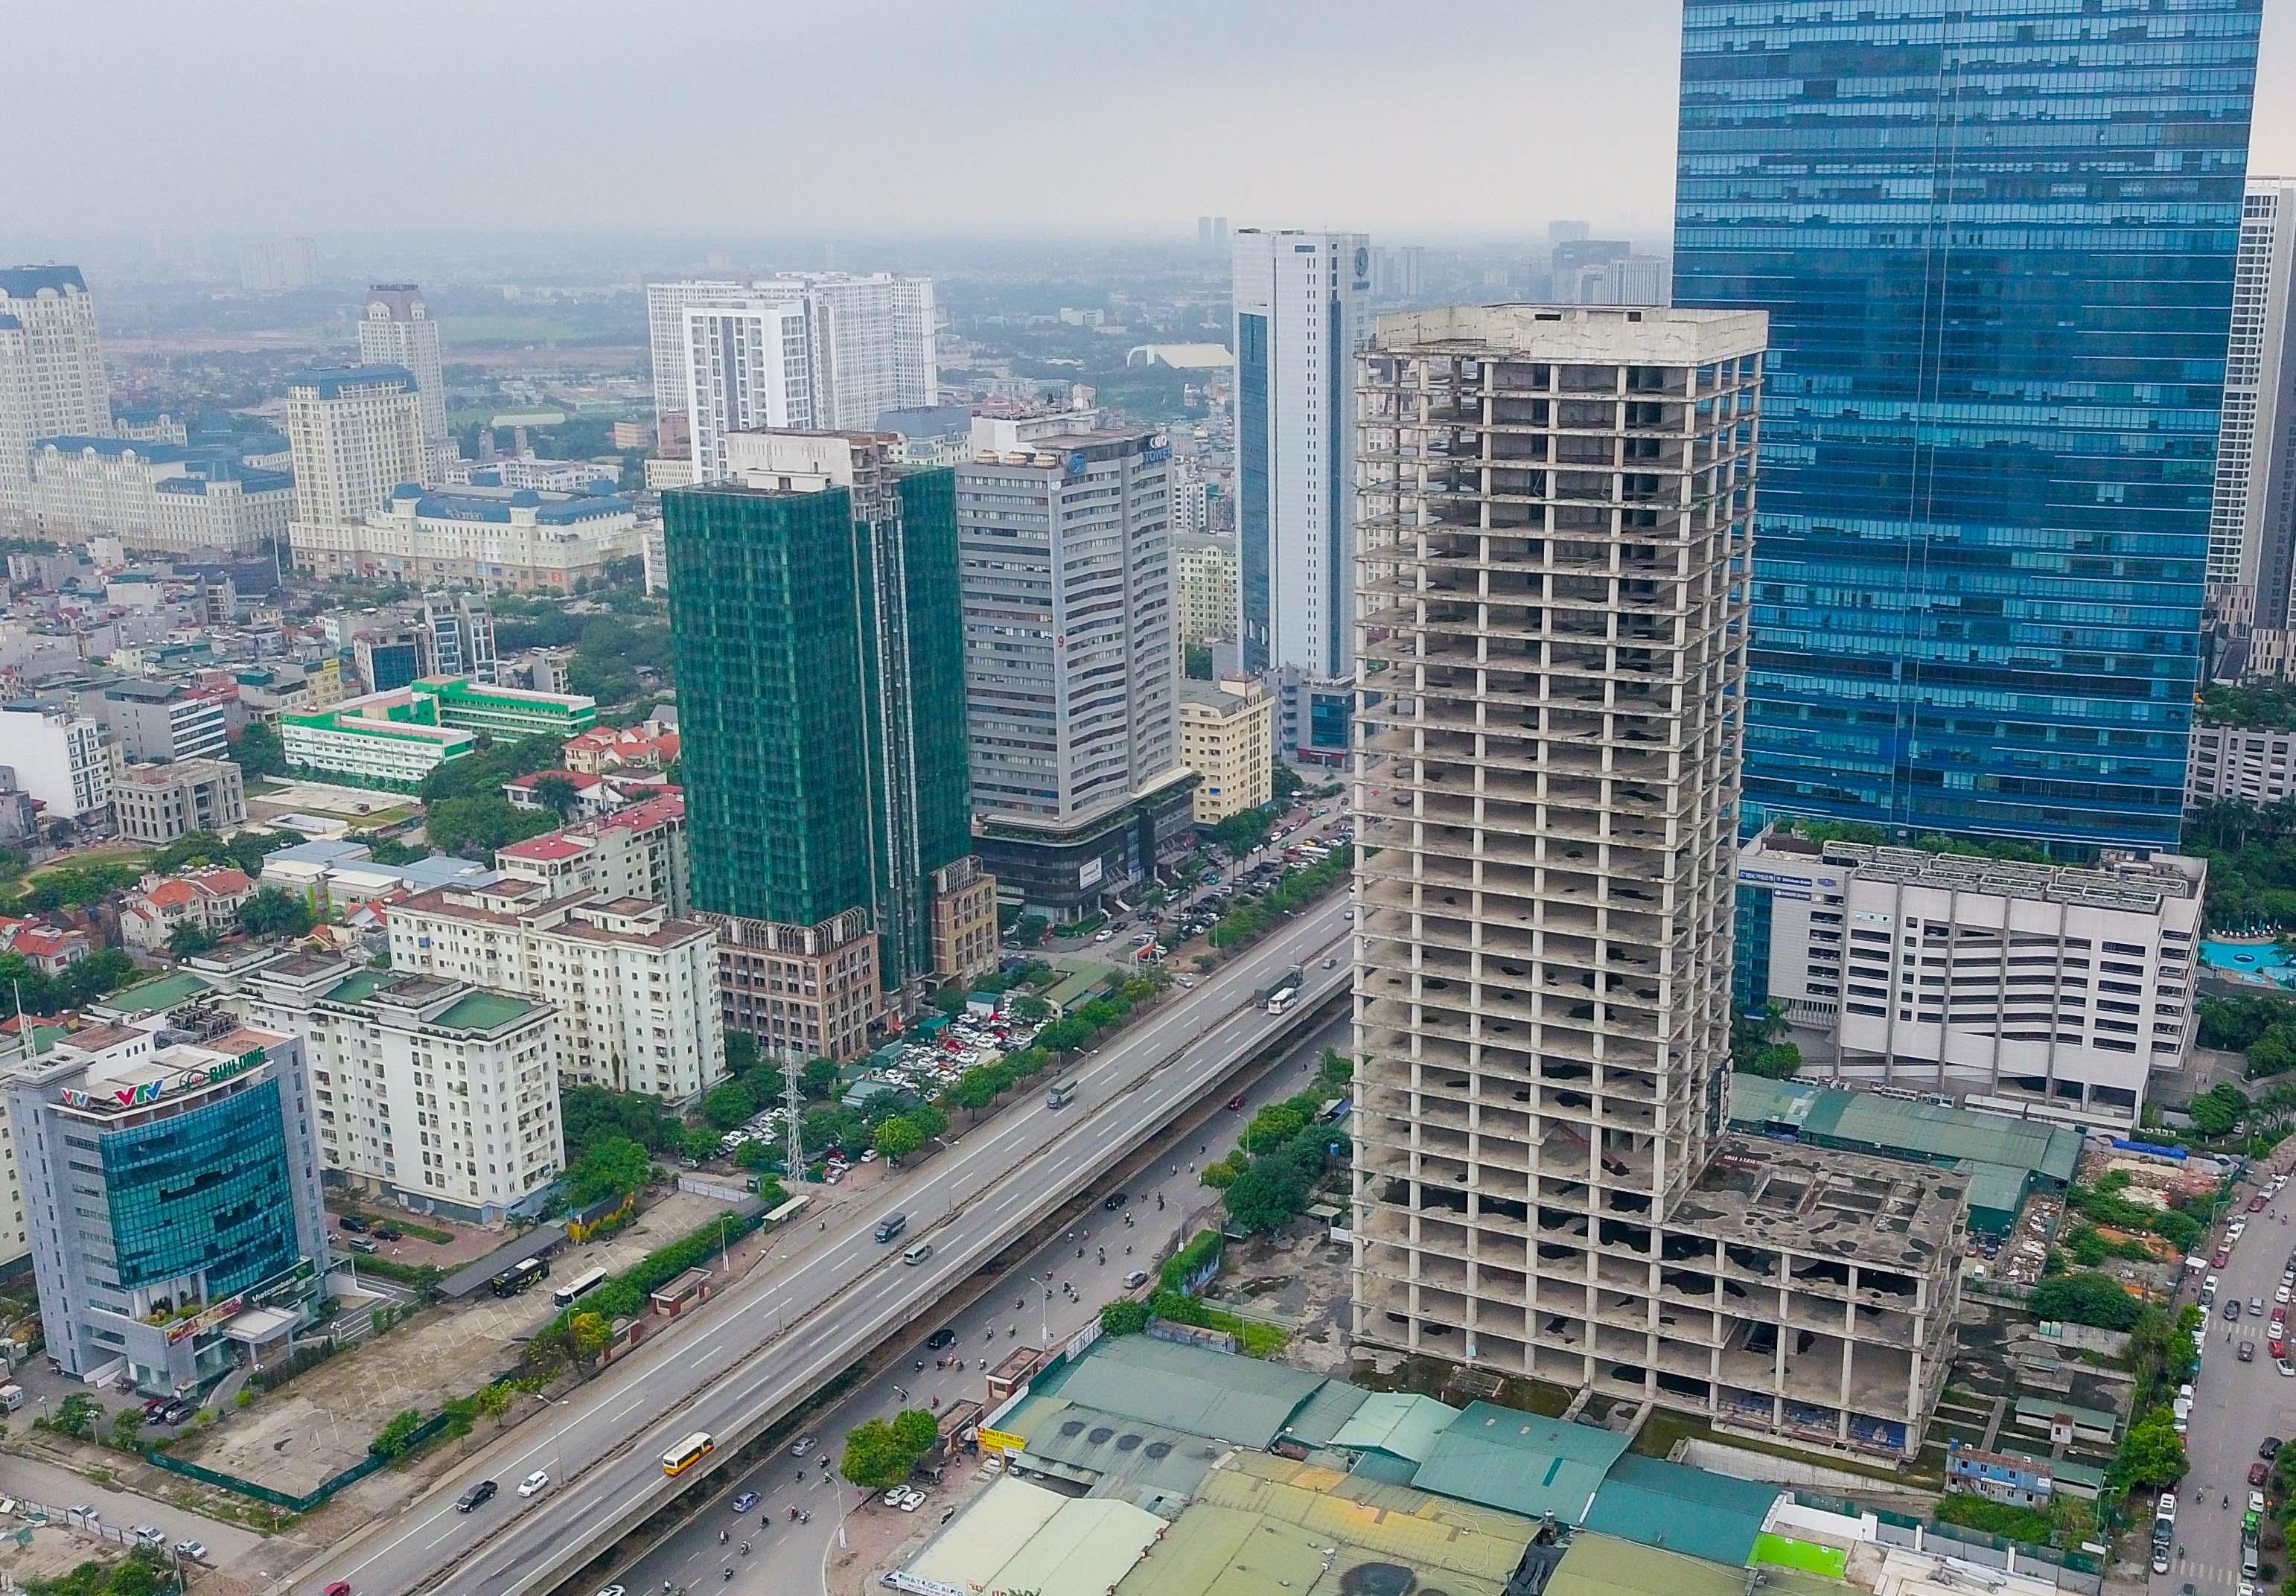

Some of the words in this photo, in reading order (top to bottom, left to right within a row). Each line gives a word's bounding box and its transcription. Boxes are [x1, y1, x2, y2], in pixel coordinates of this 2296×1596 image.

[1144, 448, 1173, 462] TOWER
[115, 1079, 164, 1107] VTV
[209, 1045, 266, 1084] BUILDING
[61, 1087, 89, 1108] VTV
[251, 1275, 297, 1303] Vietcombank
